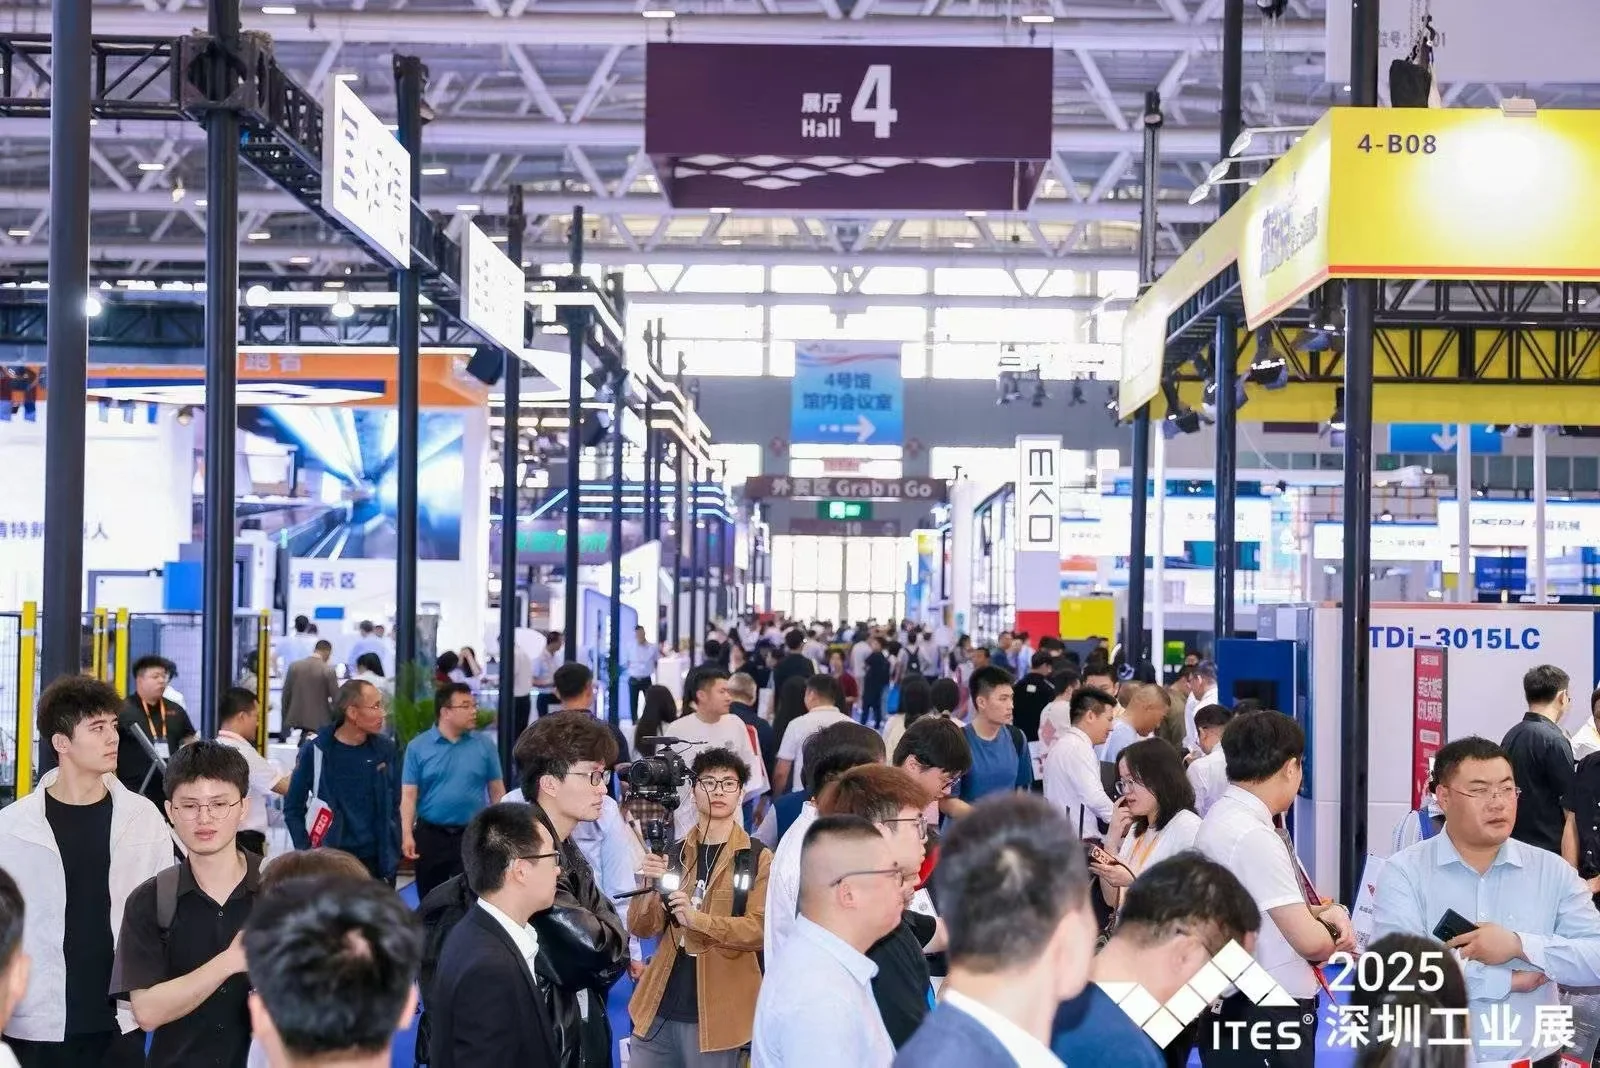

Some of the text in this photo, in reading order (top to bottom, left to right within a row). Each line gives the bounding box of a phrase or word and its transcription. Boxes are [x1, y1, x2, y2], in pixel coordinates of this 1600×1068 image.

[801, 93, 842, 114] 展厅
[850, 64, 898, 139] 4
[802, 118, 841, 138] Hall
[1357, 134, 1438, 154] 4-B08
[824, 373, 872, 390] 4号馆
[803, 392, 893, 411] 馆内会议室
[836, 479, 885, 497] Grab
[888, 482, 899, 497] n
[904, 480, 932, 497] Go
[289, 571, 356, 590] 展示区
[1368, 626, 1541, 650] TDi-3015LC
